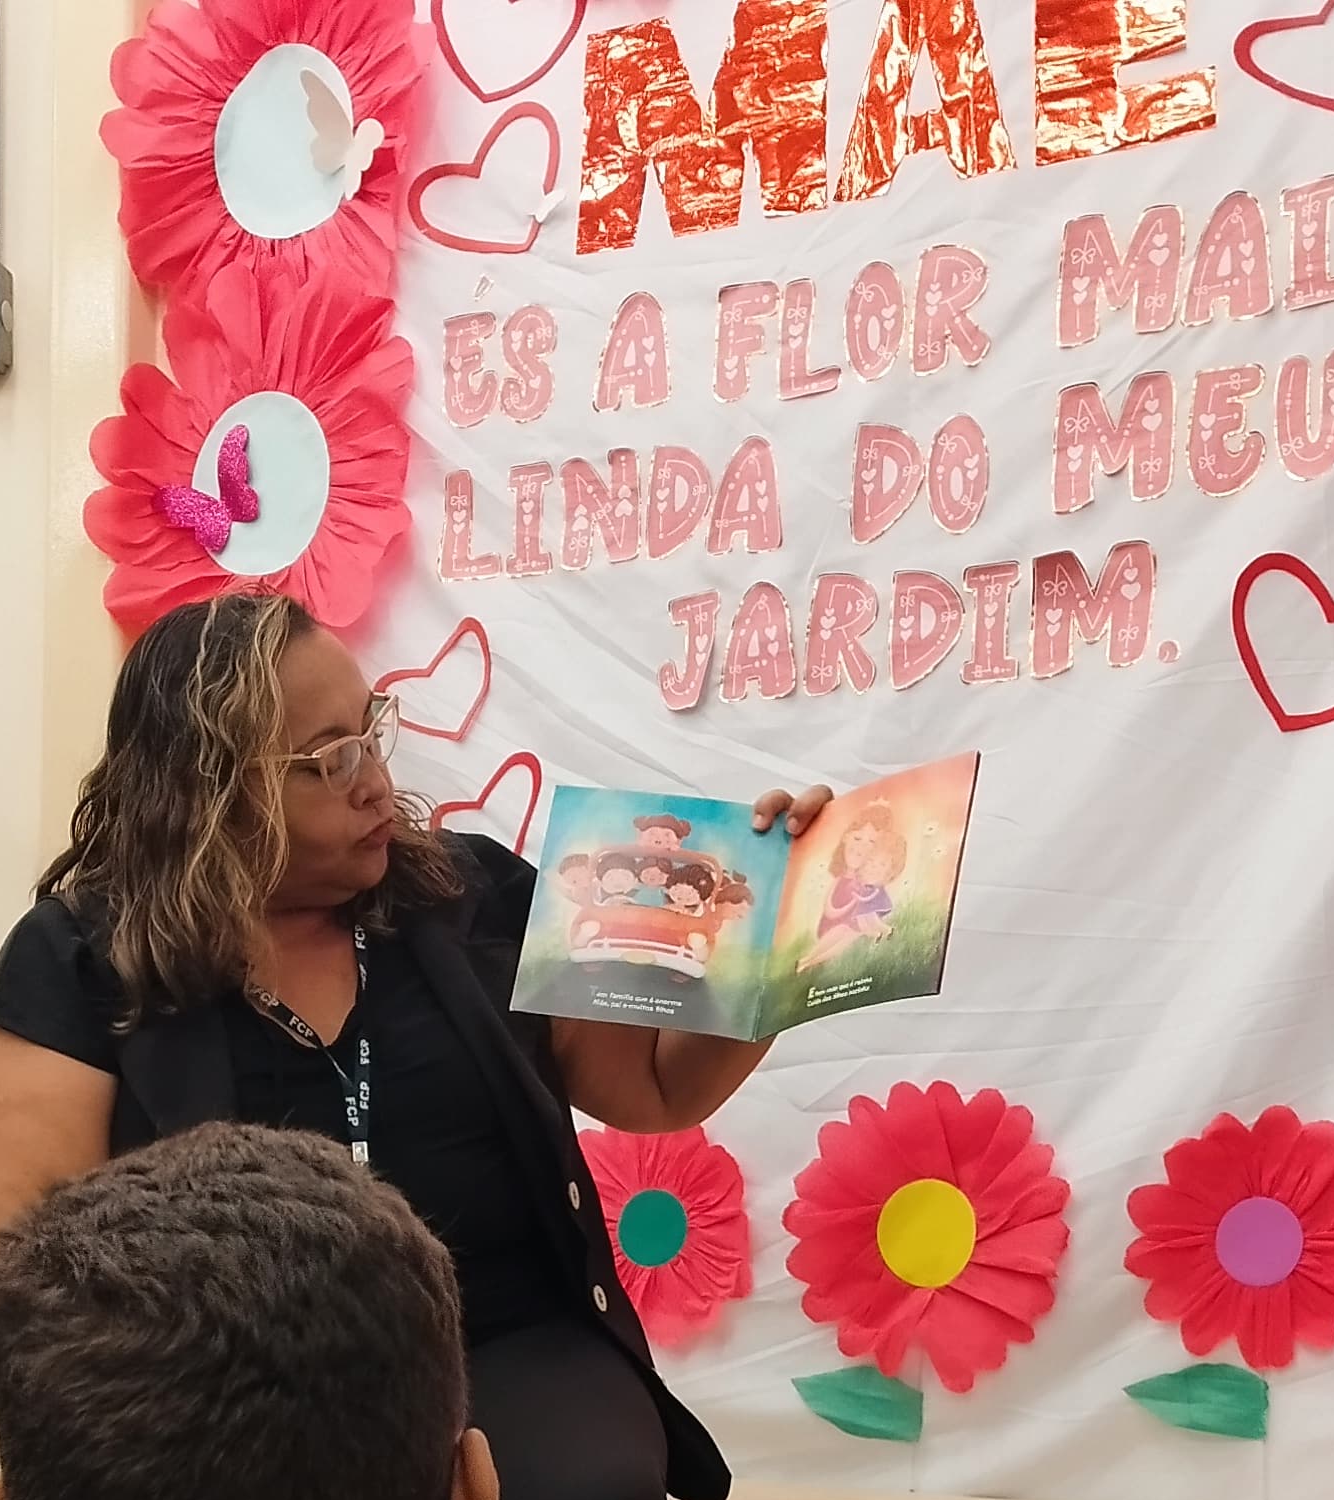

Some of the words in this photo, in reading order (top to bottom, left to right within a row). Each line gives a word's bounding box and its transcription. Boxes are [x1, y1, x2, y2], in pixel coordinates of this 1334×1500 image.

[593, 291, 672, 413] A
[712, 243, 992, 402] FLOR
[437, 434, 783, 583] LINDA
[849, 412, 990, 545] DO
[658, 539, 1182, 711] JARDIM.
[289, 1015, 314, 1037] FCP
[345, 1096, 359, 1127] FCP
[359, 1081, 370, 1110] FCP
